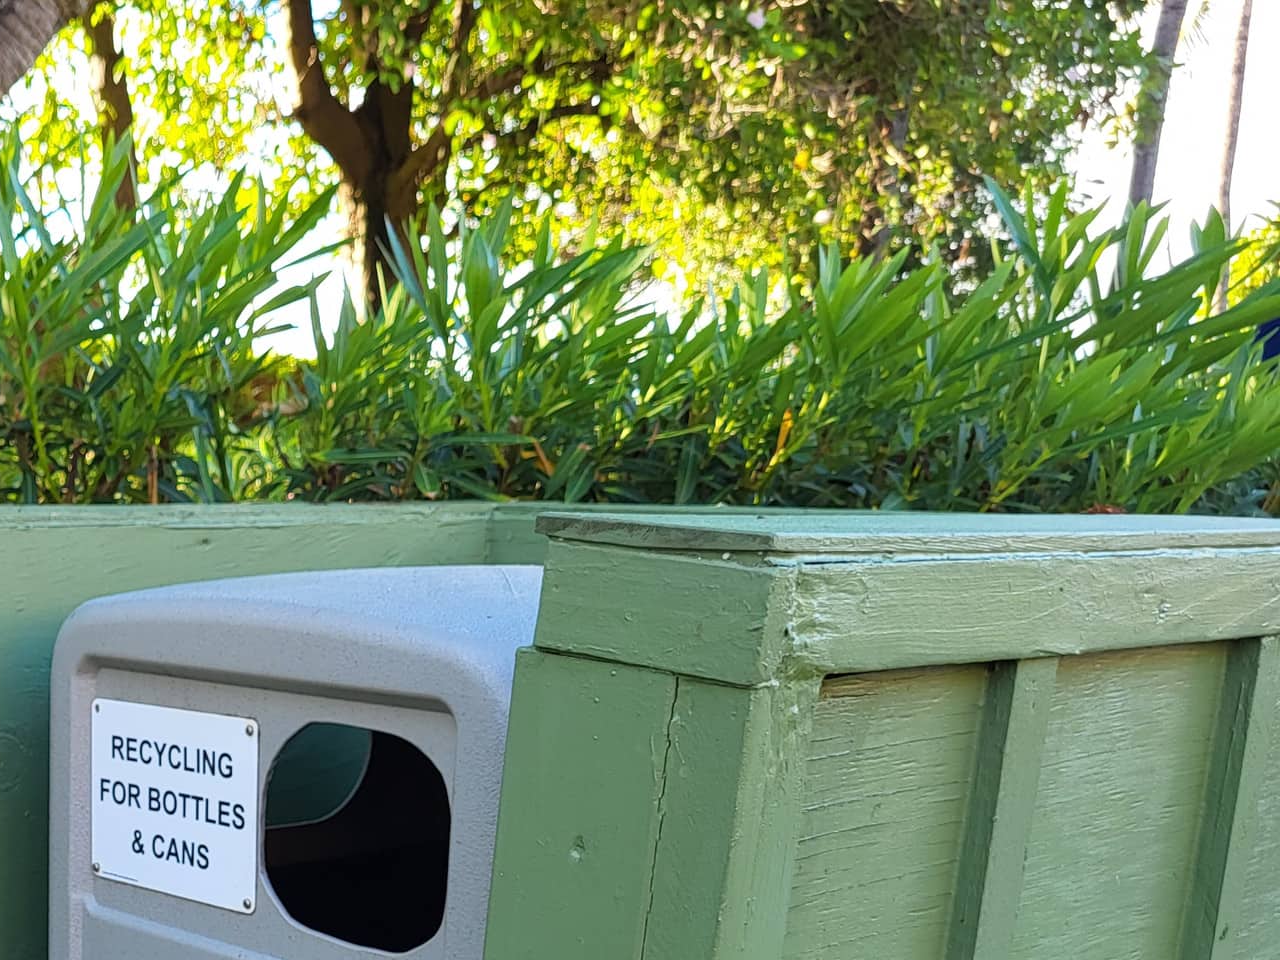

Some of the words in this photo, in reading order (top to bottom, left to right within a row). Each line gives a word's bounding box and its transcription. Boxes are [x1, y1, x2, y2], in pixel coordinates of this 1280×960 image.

[112, 735, 233, 778] RECYCLING
[100, 778, 141, 809] FOR
[148, 787, 245, 830] BOTTLES
[131, 830, 145, 855] &
[152, 834, 210, 870] CANS
